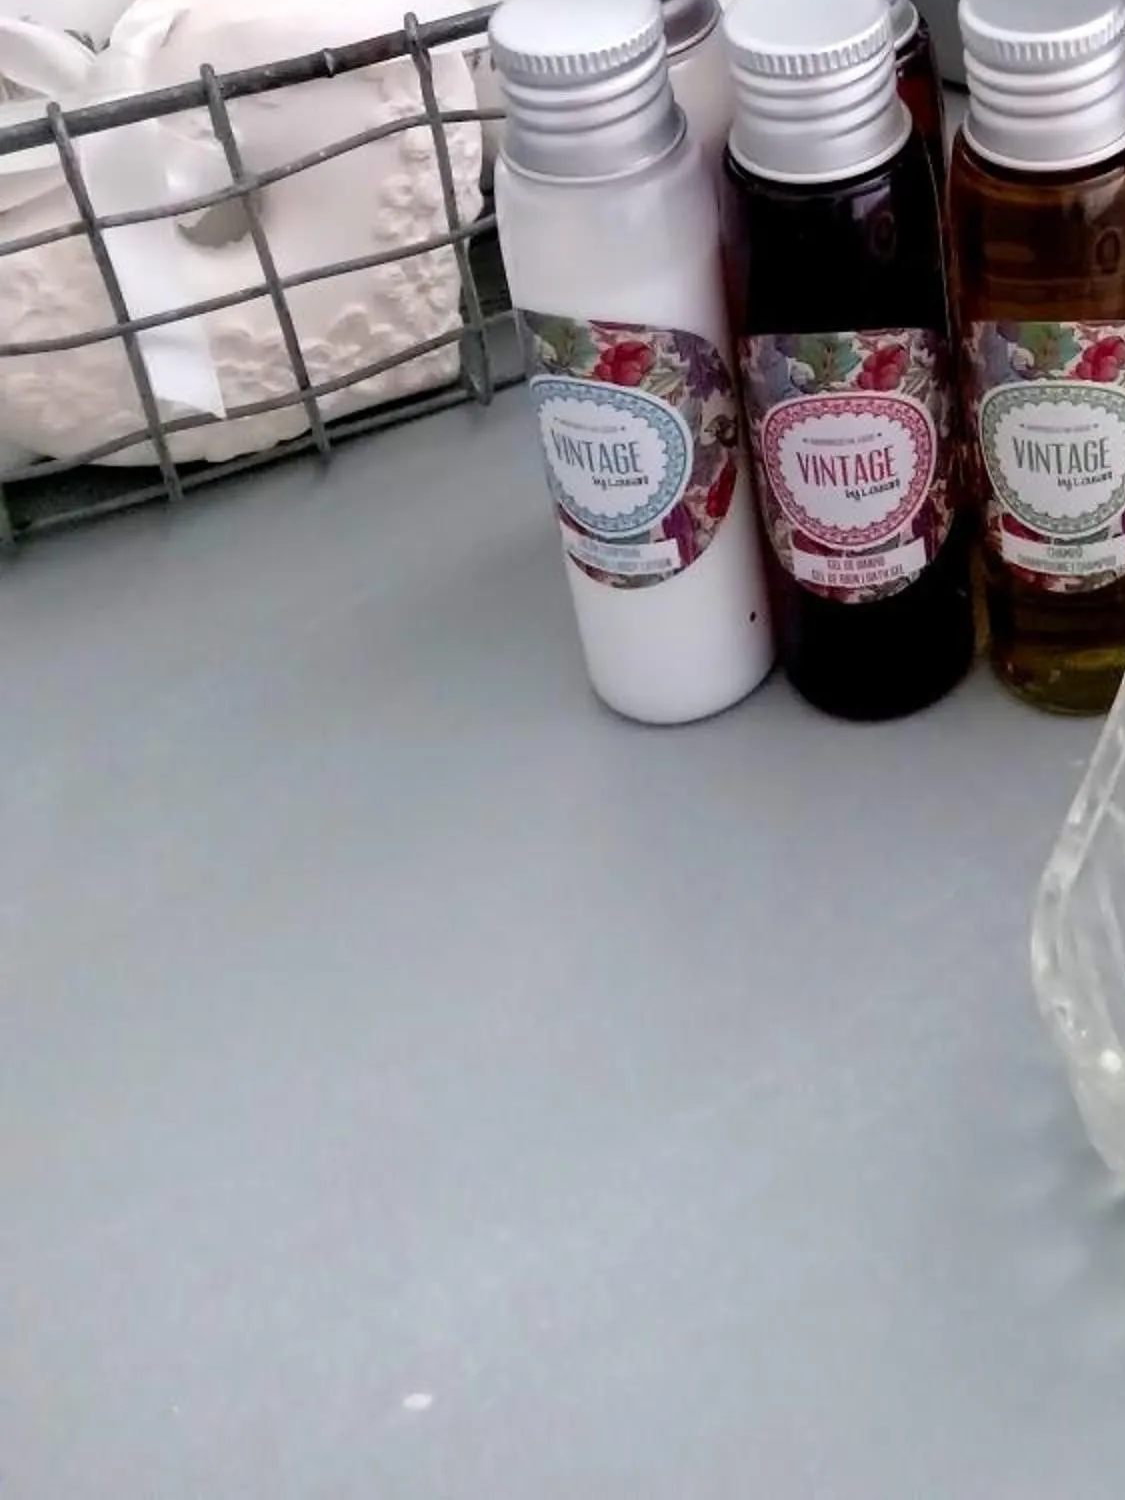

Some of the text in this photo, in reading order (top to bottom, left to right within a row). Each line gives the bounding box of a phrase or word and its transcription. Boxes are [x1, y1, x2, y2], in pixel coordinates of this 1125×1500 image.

[550, 427, 643, 475] VINTAGE
[795, 444, 898, 488] VINTAGE
[1012, 436, 1113, 475] VINTAGE
